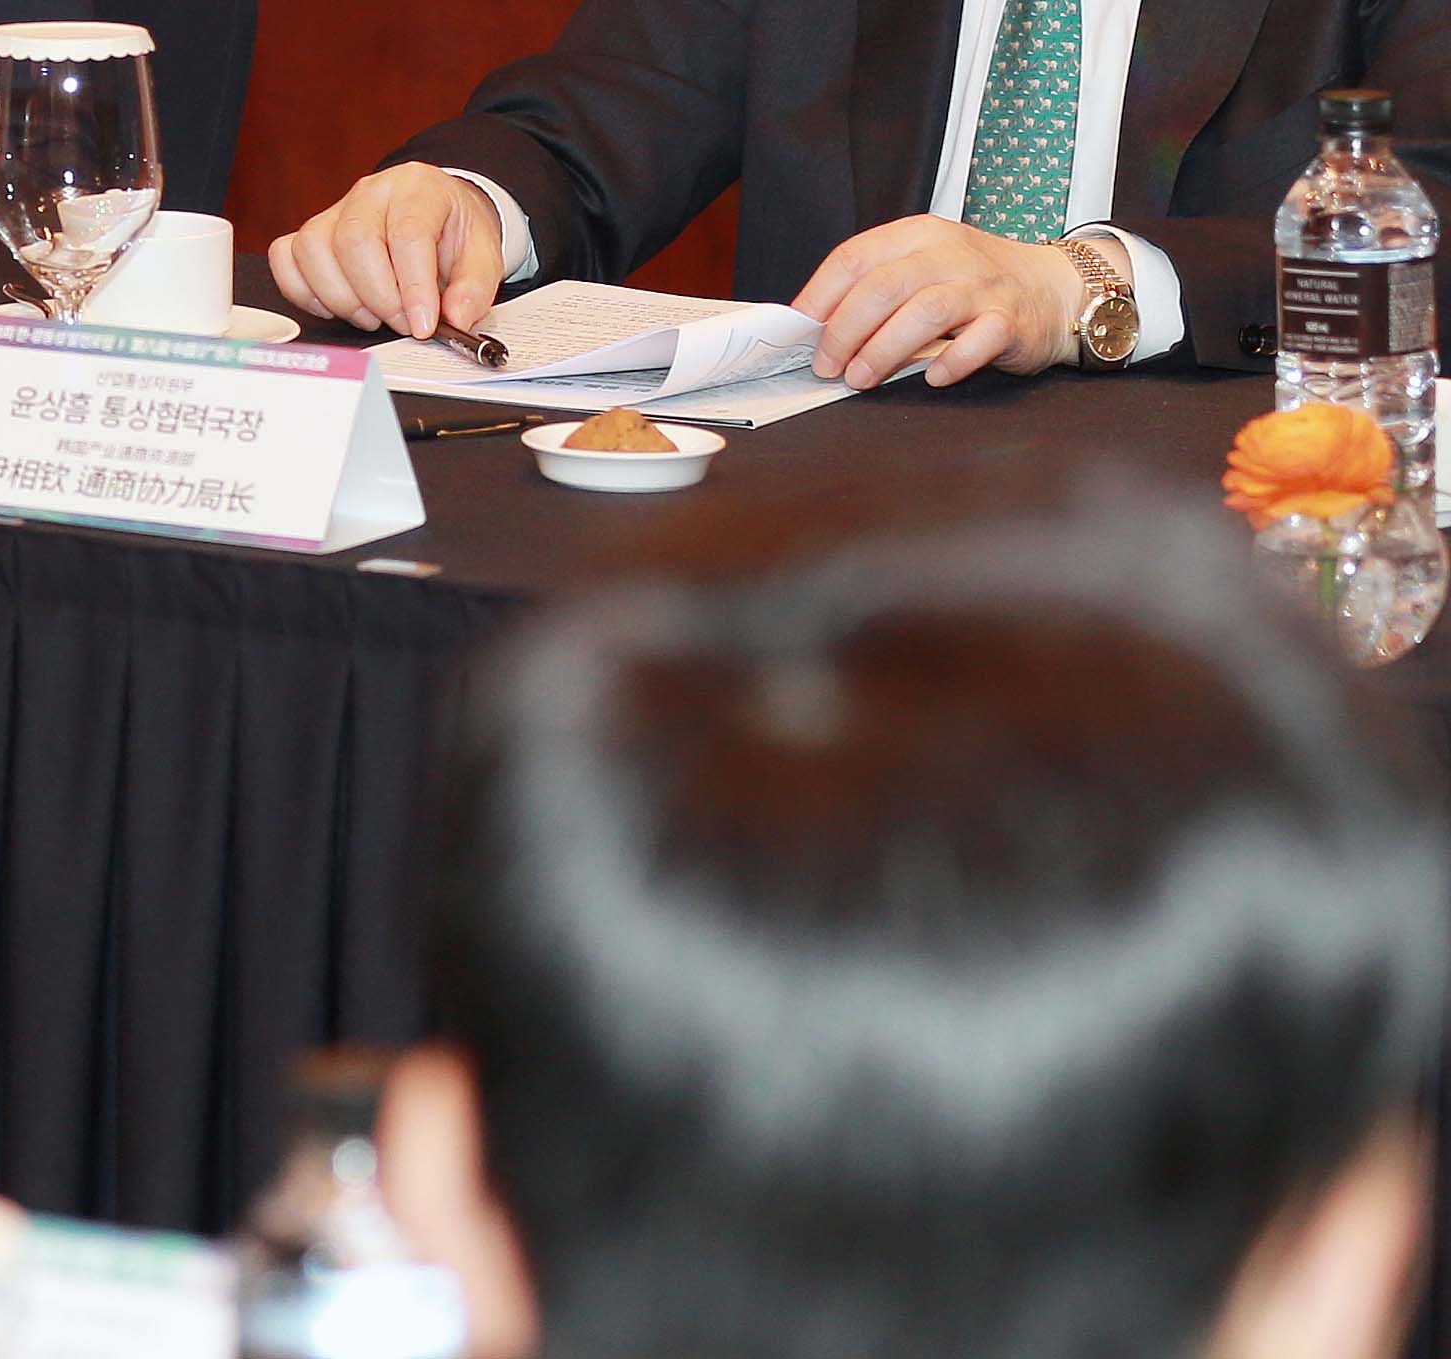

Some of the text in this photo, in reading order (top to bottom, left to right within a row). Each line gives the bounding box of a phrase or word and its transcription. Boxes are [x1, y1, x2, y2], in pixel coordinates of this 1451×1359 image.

[10, 385, 264, 442] 윤상흠 통상협력국장
[75, 465, 256, 514] 通商协力局长
